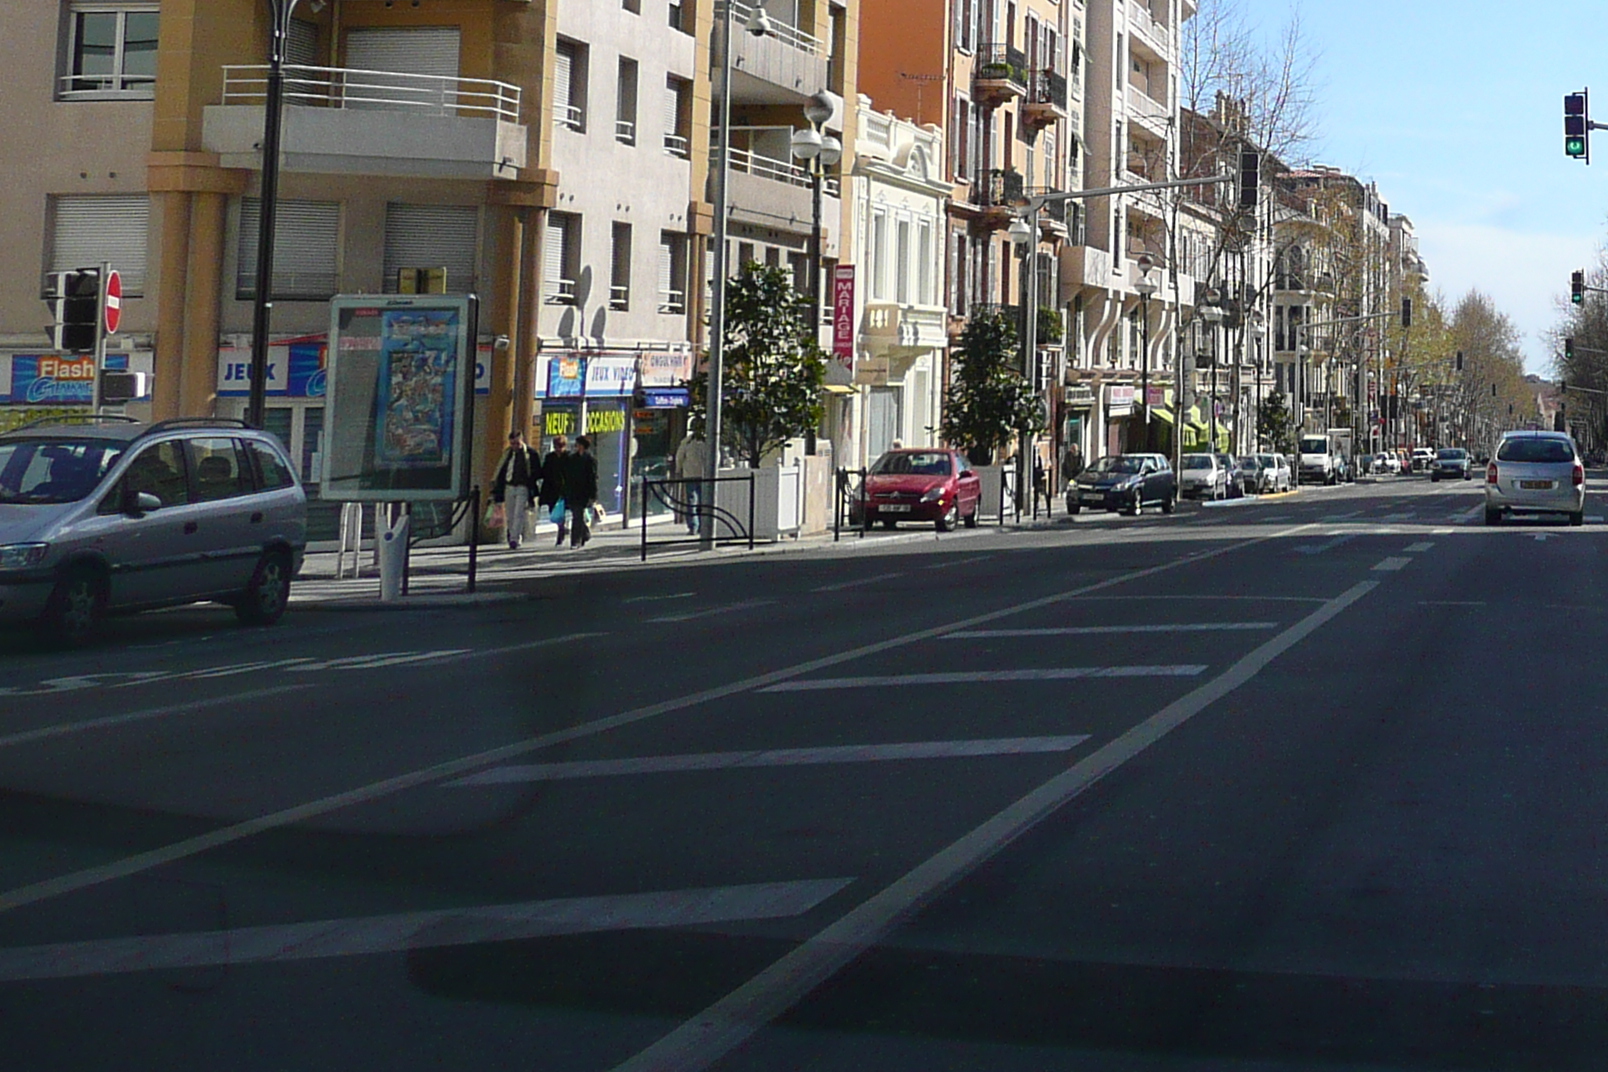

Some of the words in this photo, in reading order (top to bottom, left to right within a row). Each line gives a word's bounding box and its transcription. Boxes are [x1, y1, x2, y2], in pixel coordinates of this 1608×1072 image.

[837, 281, 852, 339] MARIAGE
[41, 360, 94, 377] Flash
[592, 366, 608, 382] JEUX
[613, 365, 635, 381] VIDEO
[586, 410, 625, 434] OCCASIONS
